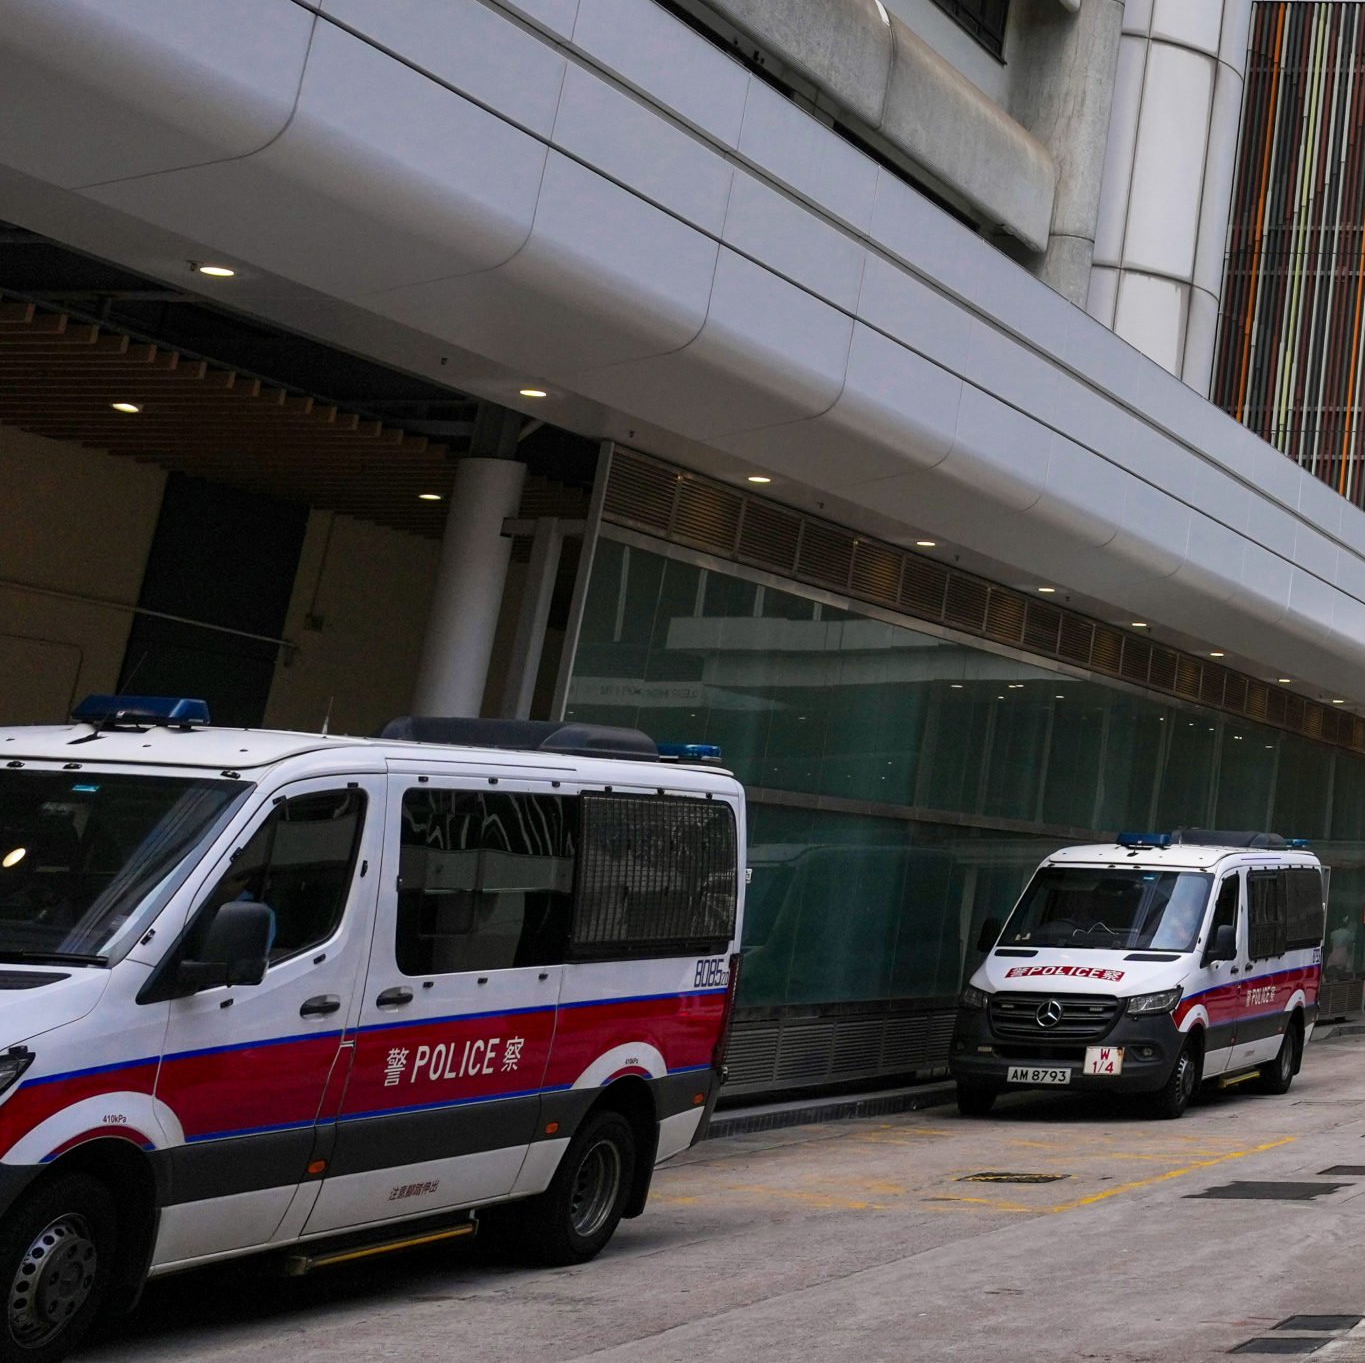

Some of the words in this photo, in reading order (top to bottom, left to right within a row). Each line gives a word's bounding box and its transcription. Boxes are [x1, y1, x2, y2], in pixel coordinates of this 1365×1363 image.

[694, 959, 724, 988] 8085
[1028, 966, 1102, 978] POLICE
[1100, 1048, 1112, 1060] W
[384, 1047, 410, 1087] 警
[410, 1037, 500, 1084] POLICE
[501, 1035, 525, 1072] 察
[1092, 1061, 1114, 1073] 1/4
[1011, 1069, 1029, 1080] AM
[1031, 1069, 1067, 1082] 8793
[102, 1114, 127, 1123] 410kPa
